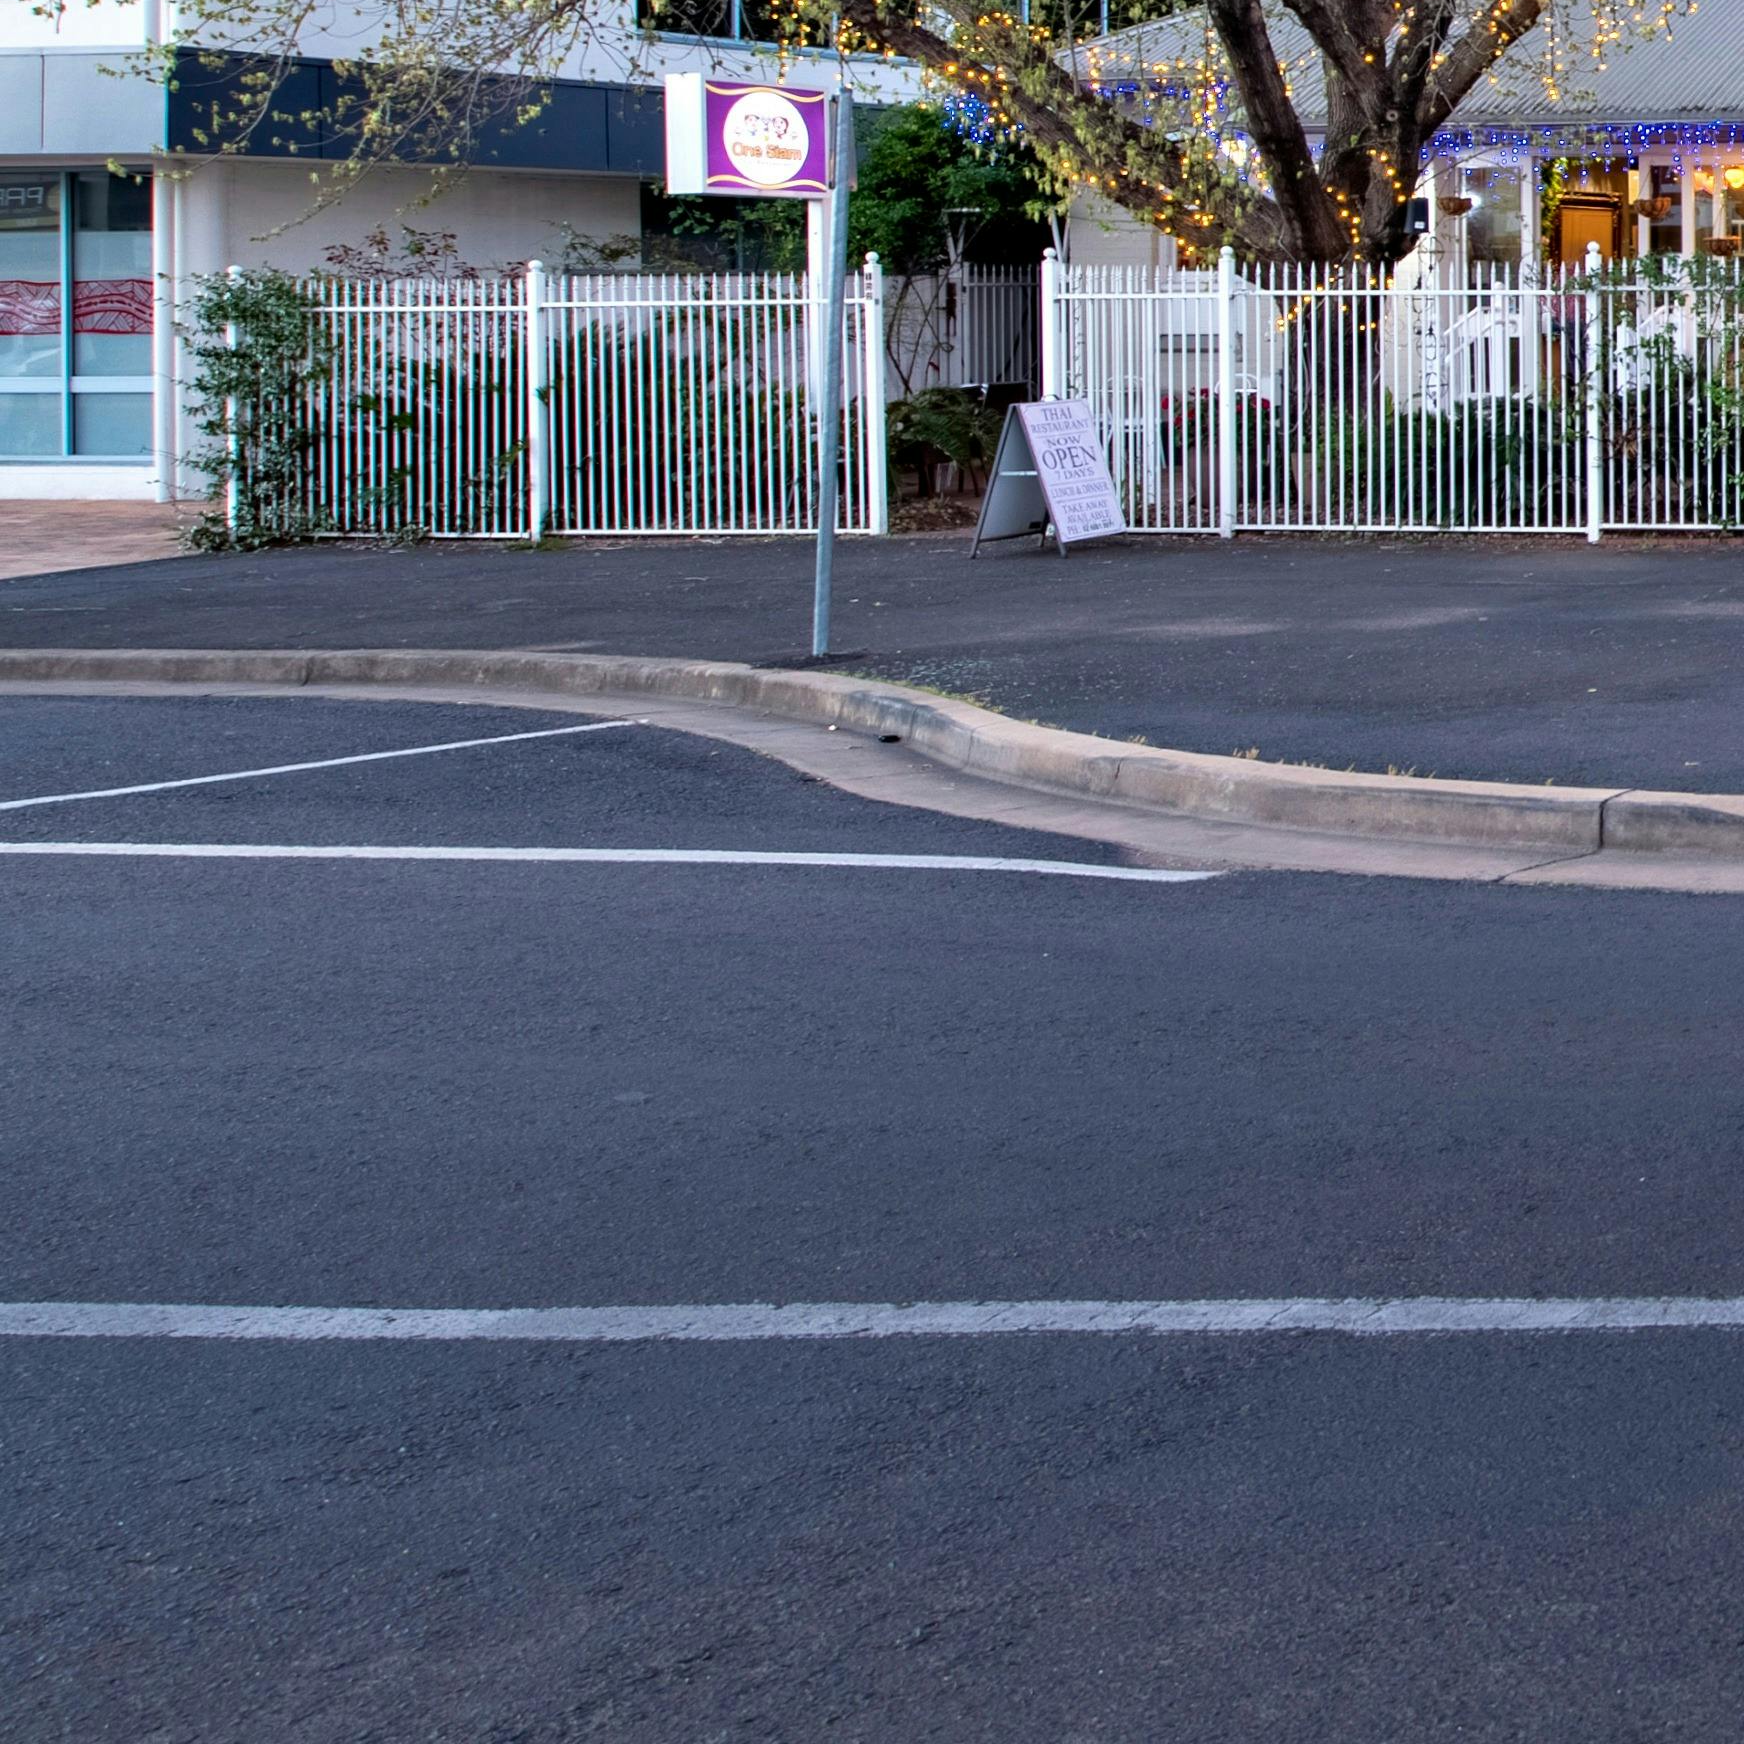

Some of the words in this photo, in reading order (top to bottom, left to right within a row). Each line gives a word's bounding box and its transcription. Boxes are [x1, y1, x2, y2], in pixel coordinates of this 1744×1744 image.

[732, 142, 762, 158] One
[766, 144, 802, 161] Siam
[1040, 406, 1073, 422] THAI
[1030, 418, 1089, 434] RESTAURANT
[1045, 435, 1081, 447] NOW
[1041, 445, 1097, 470] OPEN
[1063, 466, 1096, 480] DAYS
[1062, 502, 1086, 514] TAKE
[1086, 499, 1108, 511] AWAY
[1067, 509, 1112, 524] AVAILABLE
